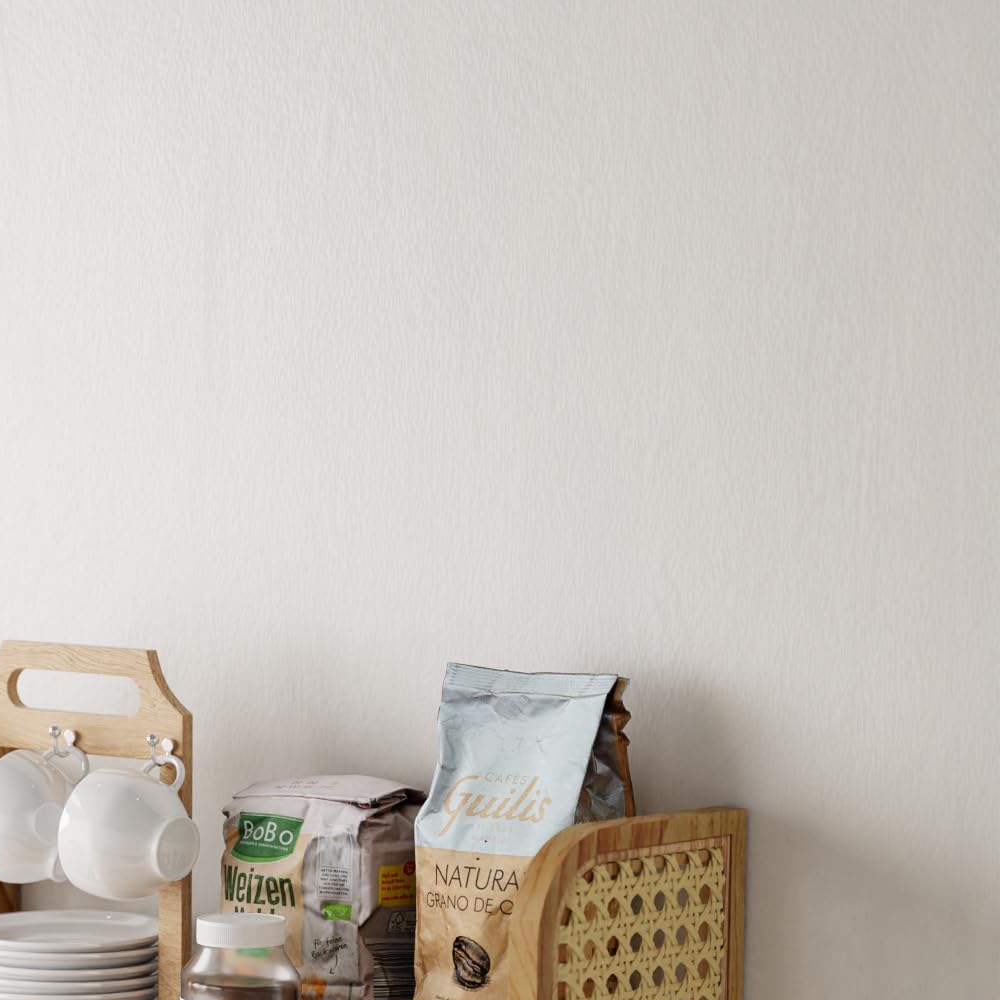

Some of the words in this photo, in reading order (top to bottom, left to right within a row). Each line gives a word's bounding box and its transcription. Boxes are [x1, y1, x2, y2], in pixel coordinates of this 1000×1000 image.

[438, 775, 553, 837] Guilis
[224, 865, 296, 908] Weizen
[435, 863, 526, 892] NATURA
[426, 891, 469, 912] GRANO
[474, 896, 495, 914] DE
